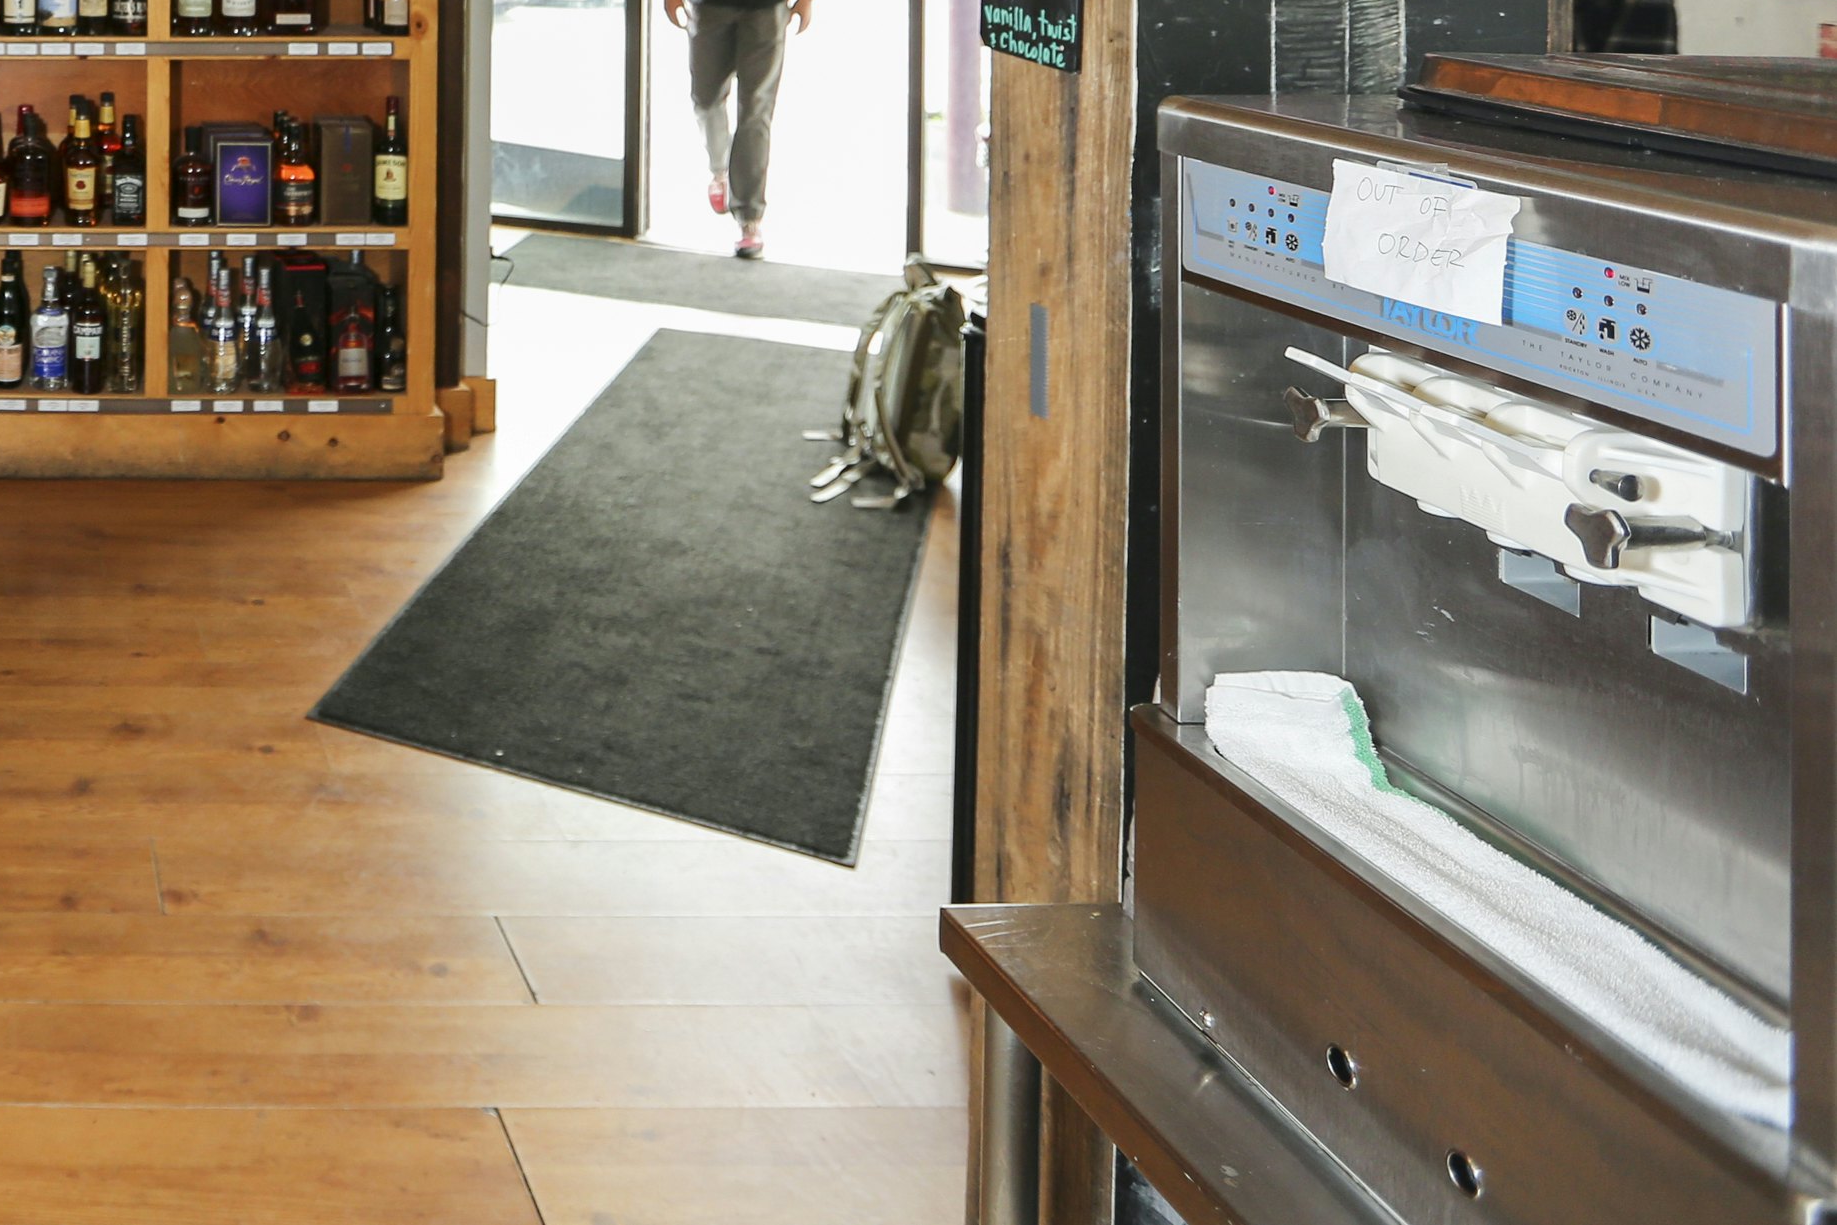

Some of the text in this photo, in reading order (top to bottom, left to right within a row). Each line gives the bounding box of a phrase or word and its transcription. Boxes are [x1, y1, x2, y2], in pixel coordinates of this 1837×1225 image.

[1037, 8, 1077, 43] twist
[1357, 176, 1449, 217] OUT OF
[1376, 232, 1465, 269] ORDER
[1618, 280, 1631, 289] LOW
[1379, 295, 1481, 345] TAYLOR
[1565, 337, 1587, 349] STANDBY
[1599, 347, 1615, 357] WASH
[1522, 339, 1704, 400] THE TAYLOR COMPANY
[1633, 356, 1648, 366] AUTO
